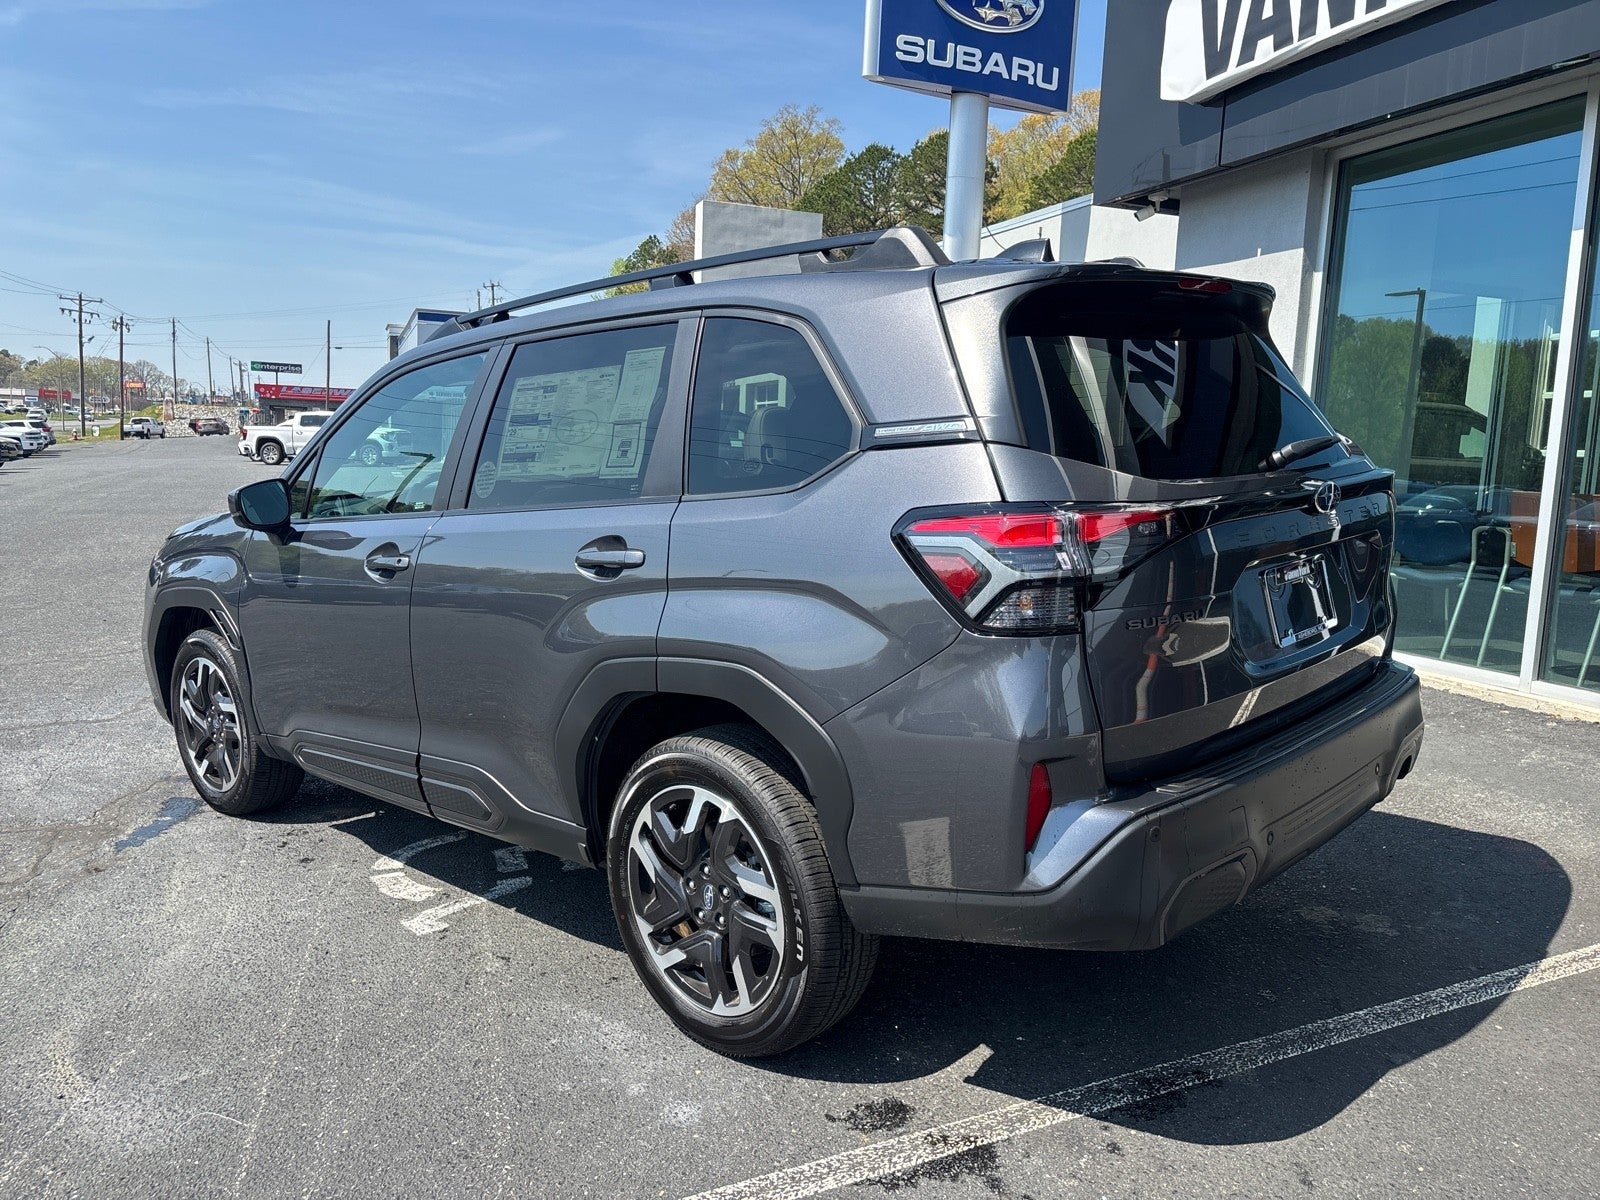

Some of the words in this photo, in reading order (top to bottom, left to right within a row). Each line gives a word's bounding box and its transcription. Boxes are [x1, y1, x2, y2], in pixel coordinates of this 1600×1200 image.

[895, 34, 1059, 91] SUBARU
[253, 363, 302, 372] enterprise
[281, 386, 357, 396] LASERW
[1126, 608, 1206, 630] SUBARU
